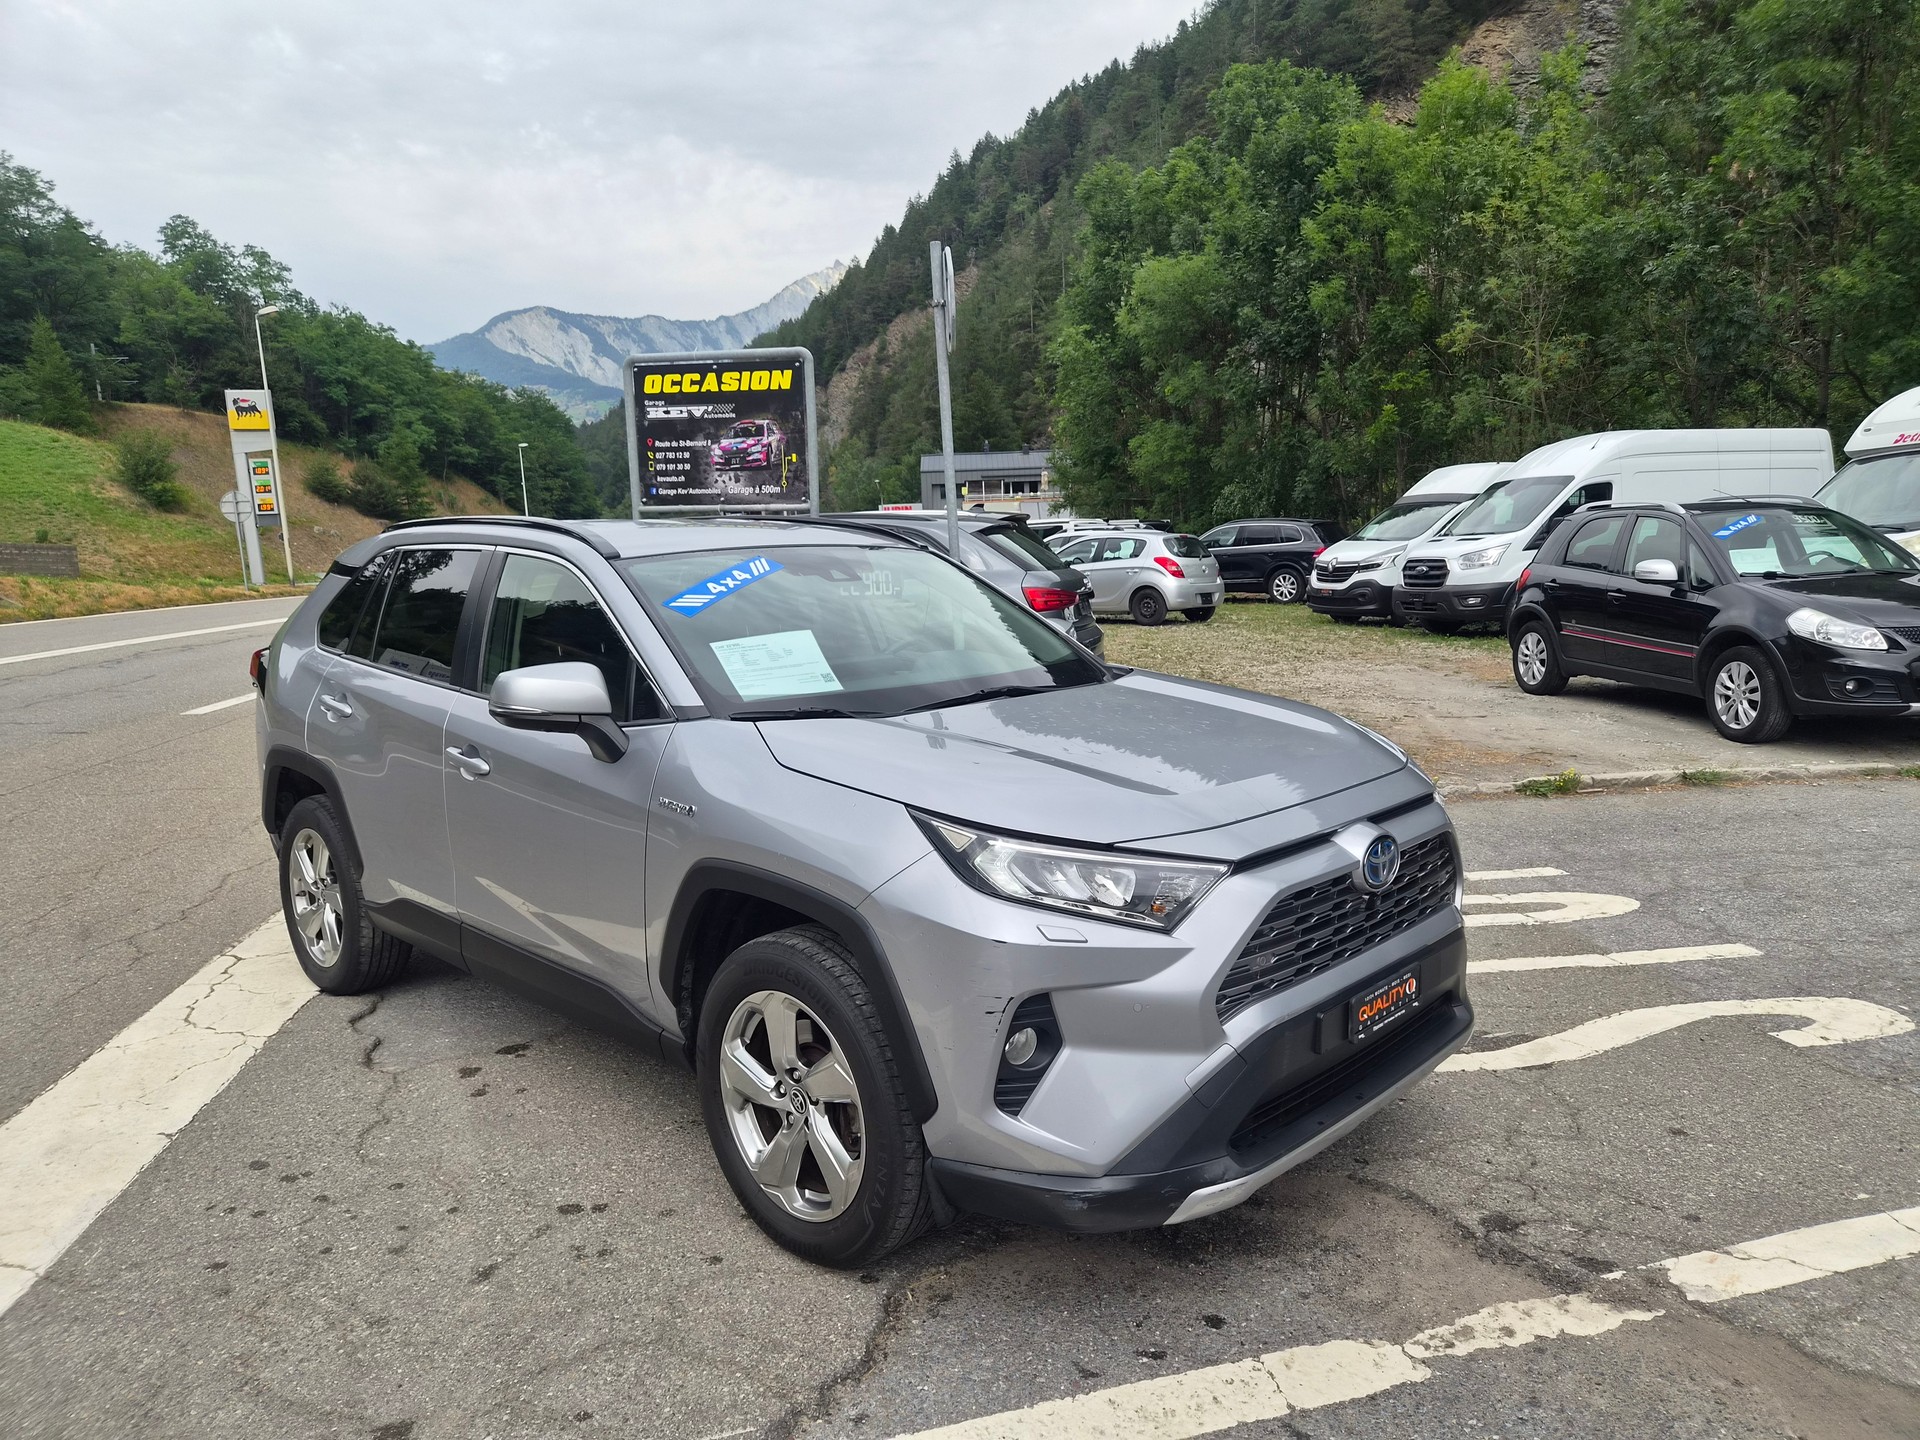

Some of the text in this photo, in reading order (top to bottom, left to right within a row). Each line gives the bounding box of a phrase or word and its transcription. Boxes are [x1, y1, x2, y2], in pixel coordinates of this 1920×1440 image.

[643, 370, 792, 394] OCCASION
[679, 439, 707, 447] St-Bernard
[658, 488, 677, 496] Garage
[728, 485, 754, 496] Garage
[761, 485, 781, 494] 500m
[706, 570, 752, 594] 4x4
